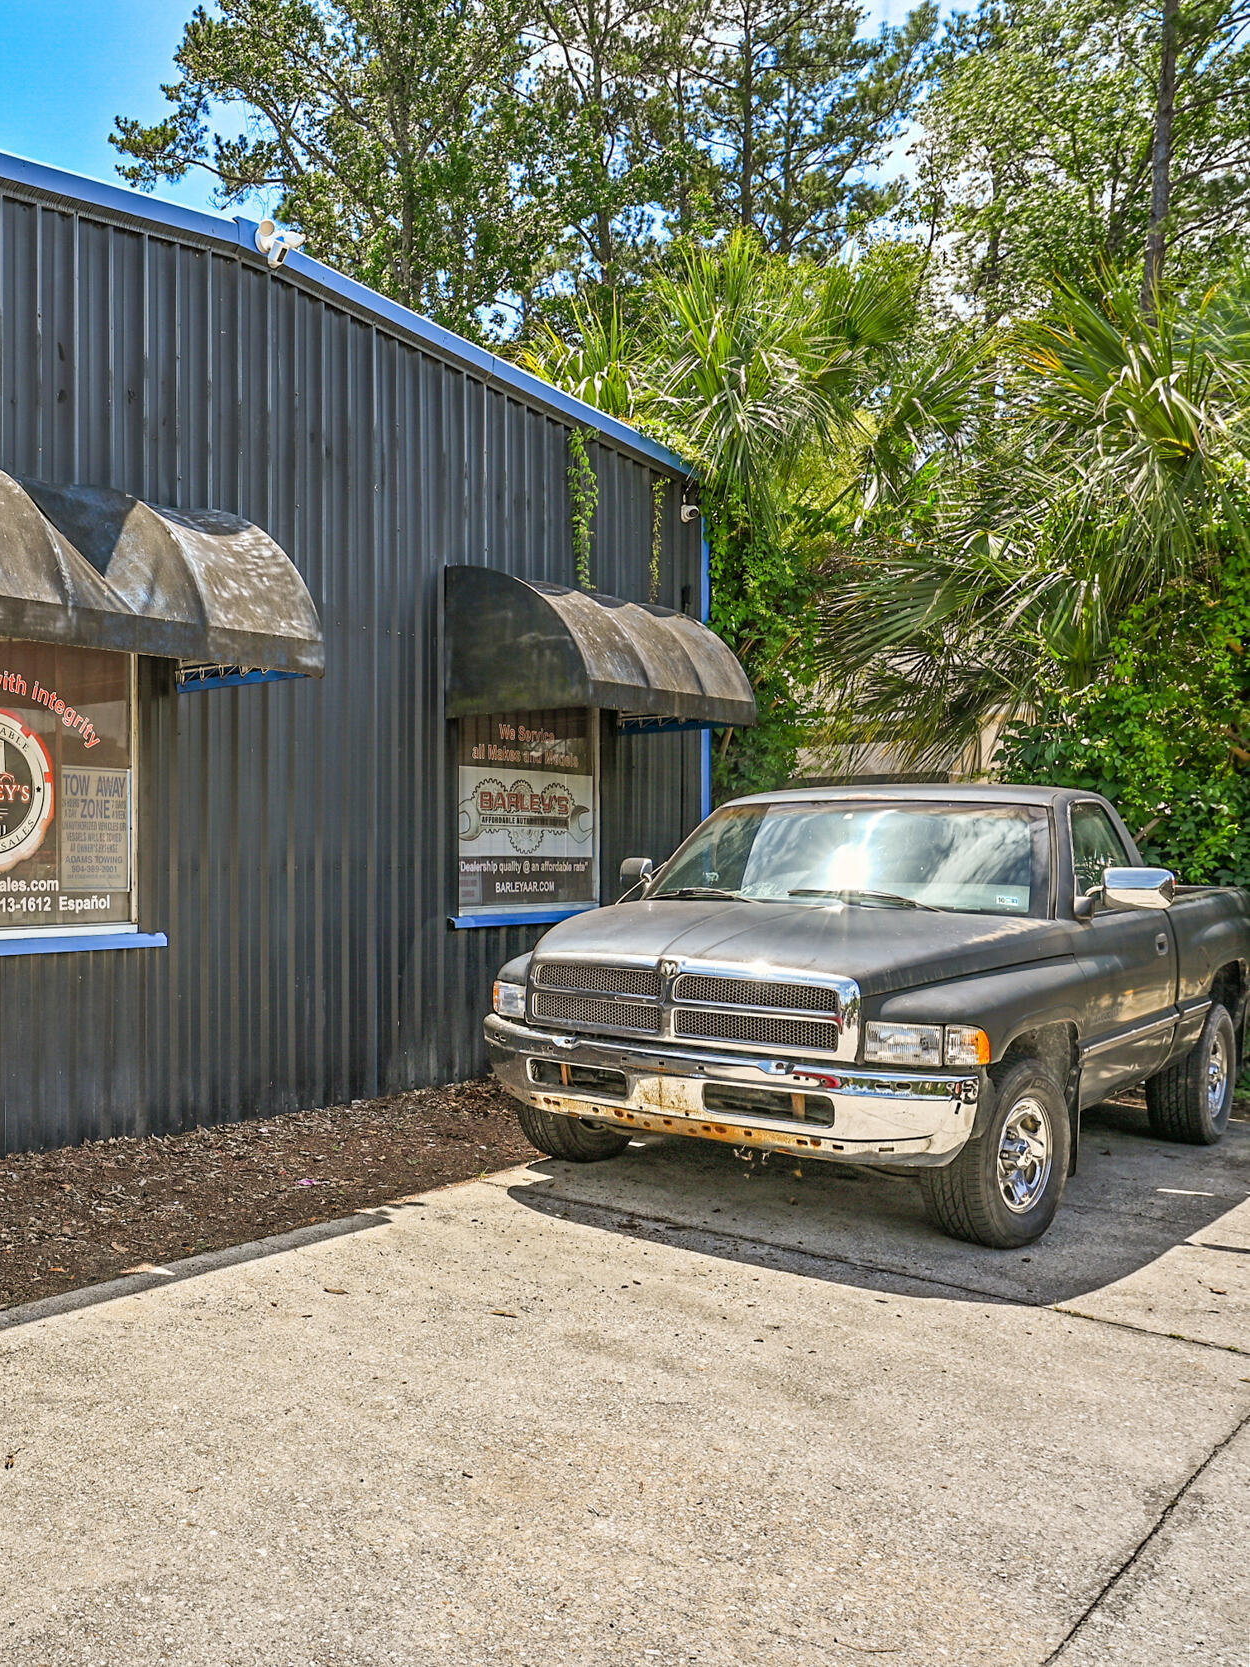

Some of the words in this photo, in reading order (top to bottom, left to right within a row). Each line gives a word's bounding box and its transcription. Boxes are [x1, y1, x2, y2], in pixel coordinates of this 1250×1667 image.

[31, 680, 101, 749] integrity
[498, 723, 516, 741] We
[517, 725, 556, 744] Service
[471, 743, 486, 760] all
[487, 744, 521, 762] Makes
[63, 774, 90, 796] TOW
[96, 775, 126, 798] AWAY
[81, 799, 110, 818] ZONE
[480, 791, 569, 814] BARLEY'S
[481, 815, 516, 825] AFFORDABLE
[0, 820, 35, 851] SALES
[65, 855, 93, 864] ADAMS
[94, 855, 123, 864] TOWING
[498, 861, 521, 875] quality
[522, 861, 531, 874] @
[531, 863, 540, 873] an
[540, 860, 572, 873] affordable
[495, 881, 555, 893] BARLEYAAR.COM
[58, 894, 110, 914] Español
